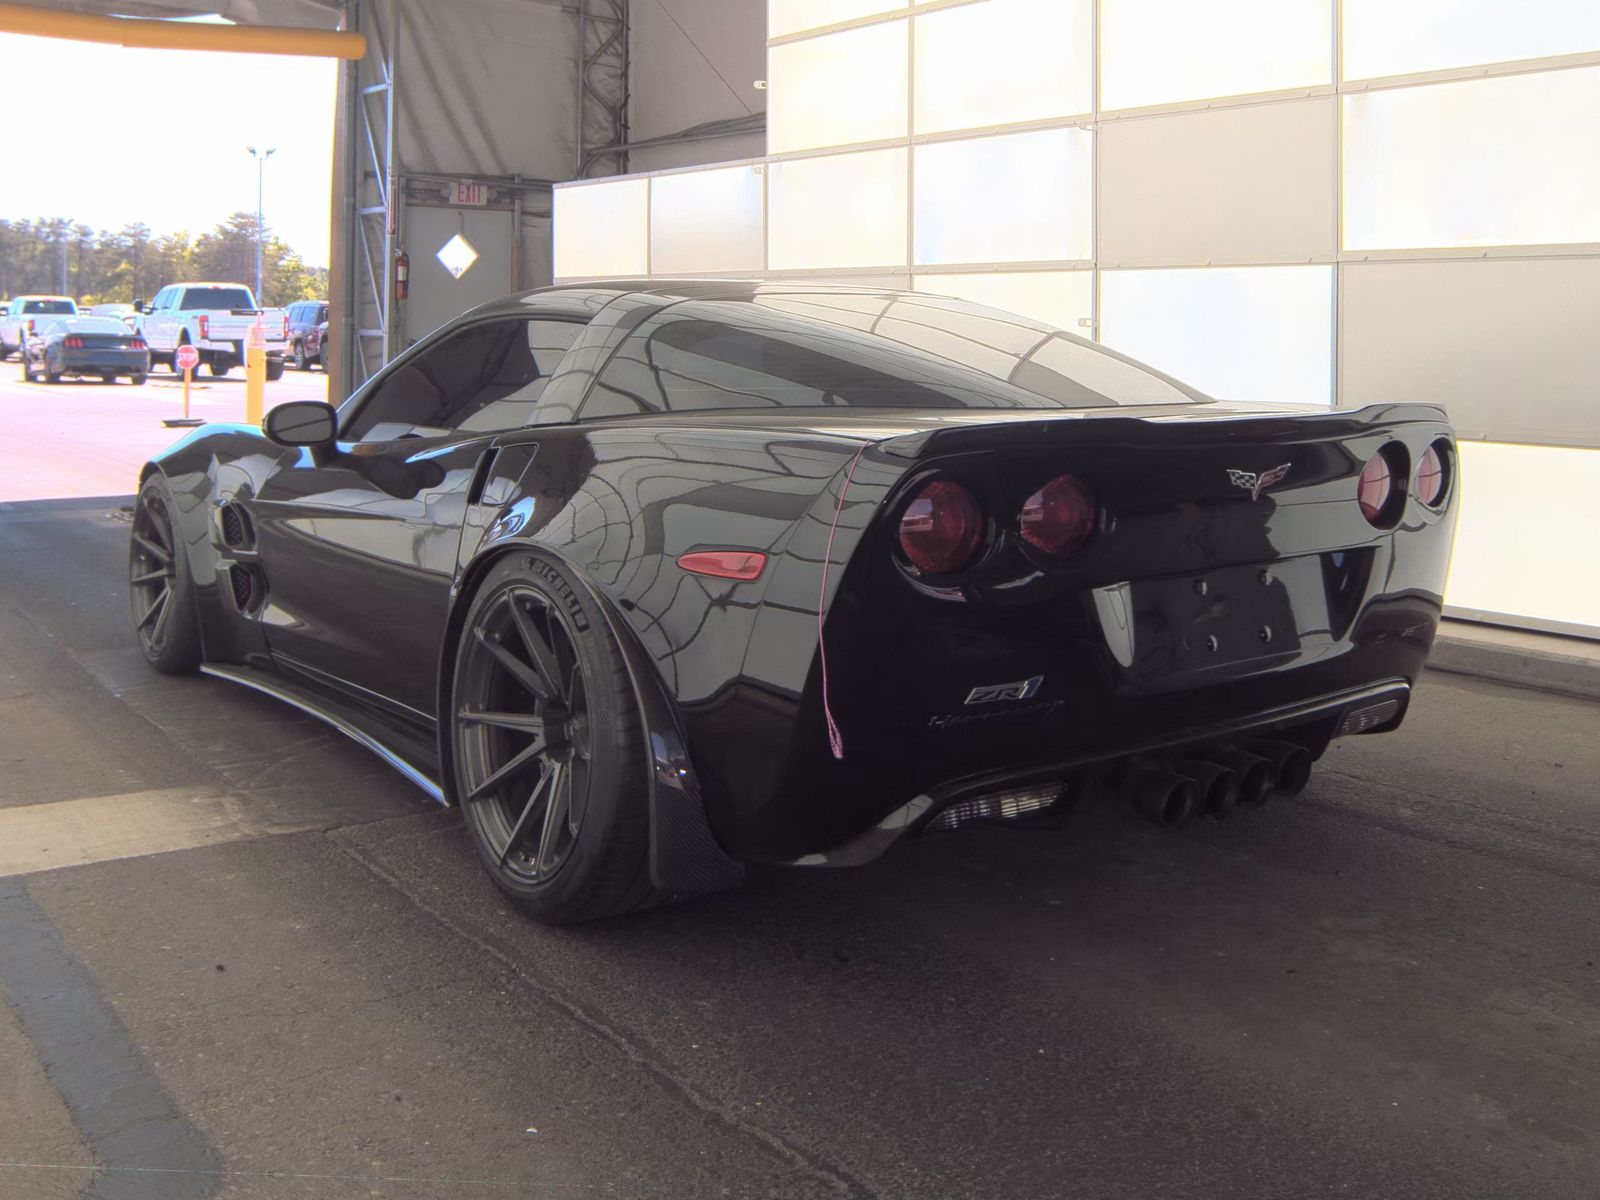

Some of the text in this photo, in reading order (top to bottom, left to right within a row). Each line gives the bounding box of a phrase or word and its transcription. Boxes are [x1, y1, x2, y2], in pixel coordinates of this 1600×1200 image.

[457, 182, 484, 204] EXIT
[177, 352, 197, 362] STOP
[529, 557, 590, 632] MICHELIN
[965, 675, 1044, 704] ZR1
